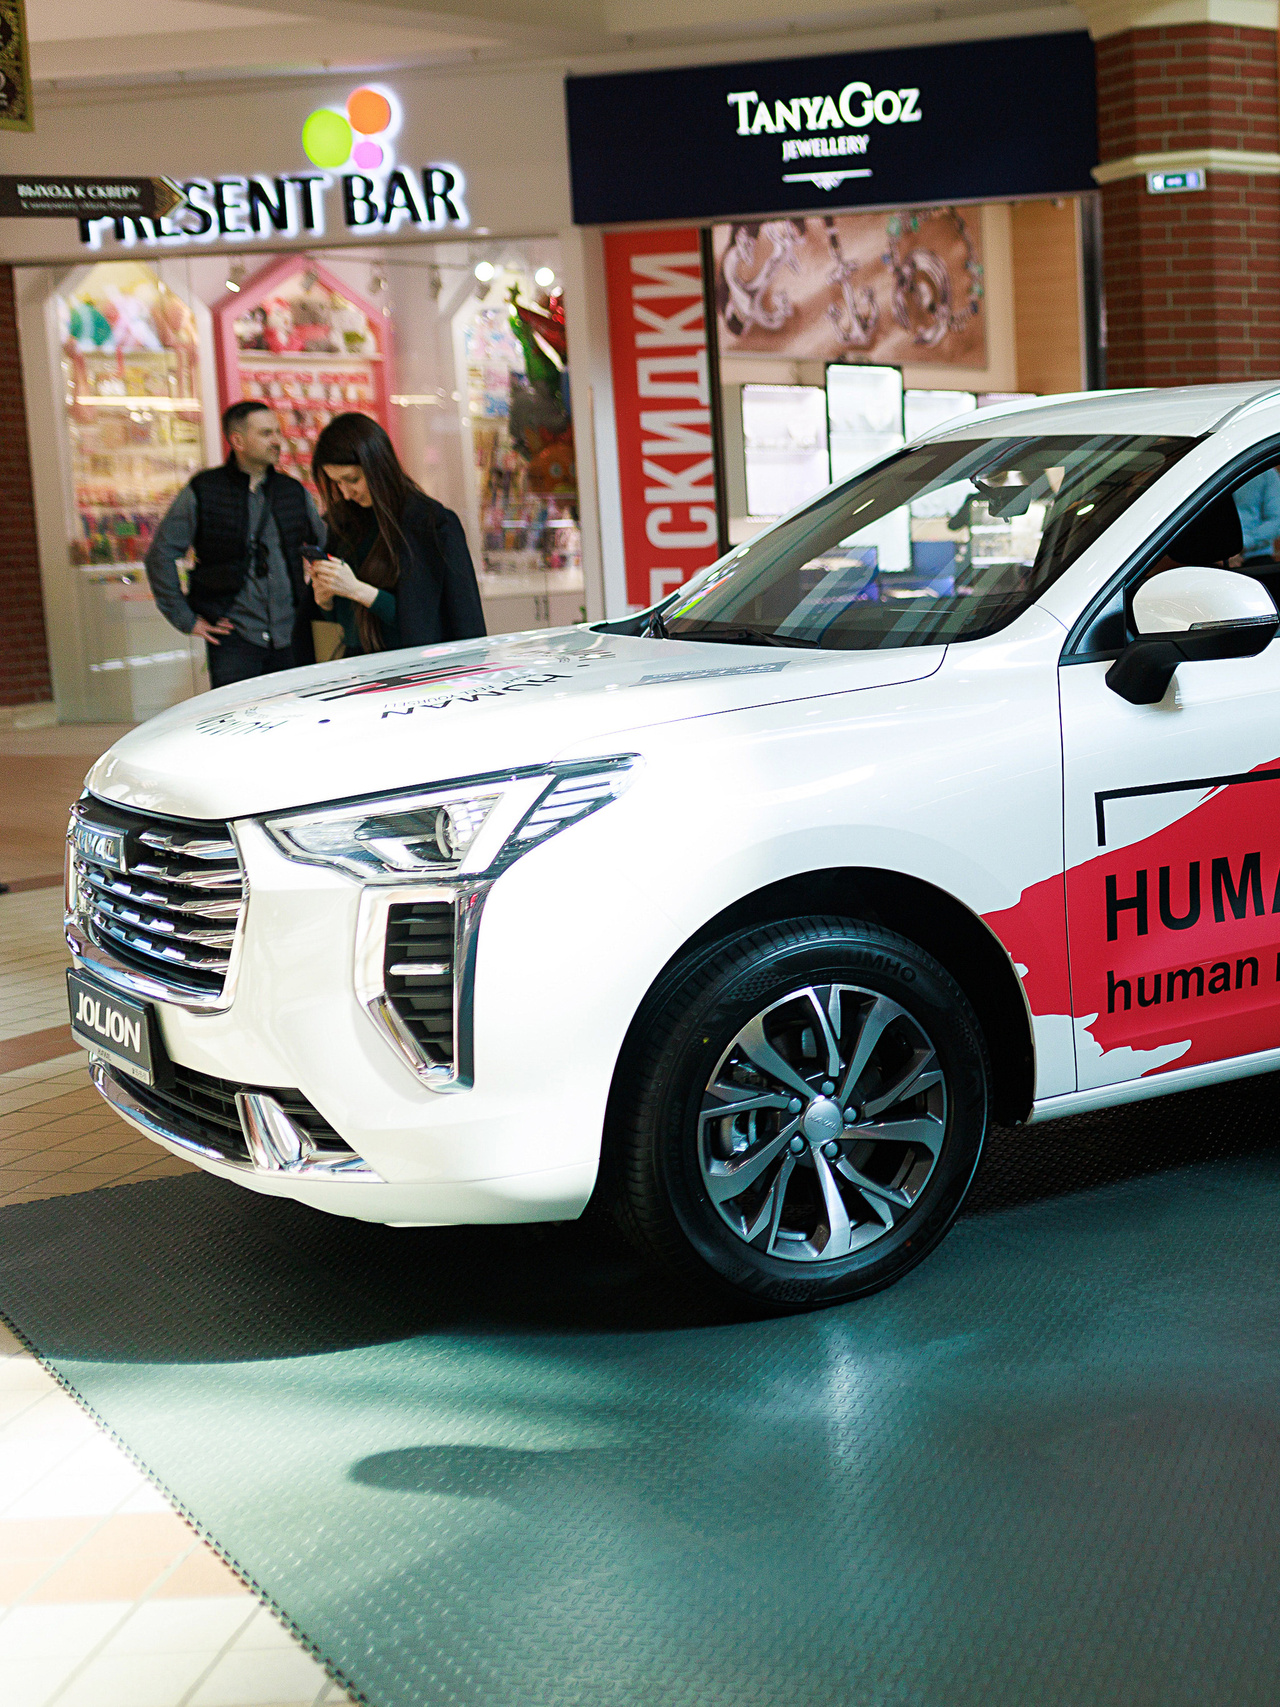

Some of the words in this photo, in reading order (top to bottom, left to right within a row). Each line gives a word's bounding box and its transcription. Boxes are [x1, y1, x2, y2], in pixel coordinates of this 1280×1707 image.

[781, 133, 871, 163] JEWELLERY
[342, 166, 465, 230] BAR
[629, 251, 719, 549] СКИДКИ
[381, 672, 574, 720] HUMAN
[1106, 956, 1259, 1014] human
[75, 992, 141, 1054] JOLION
